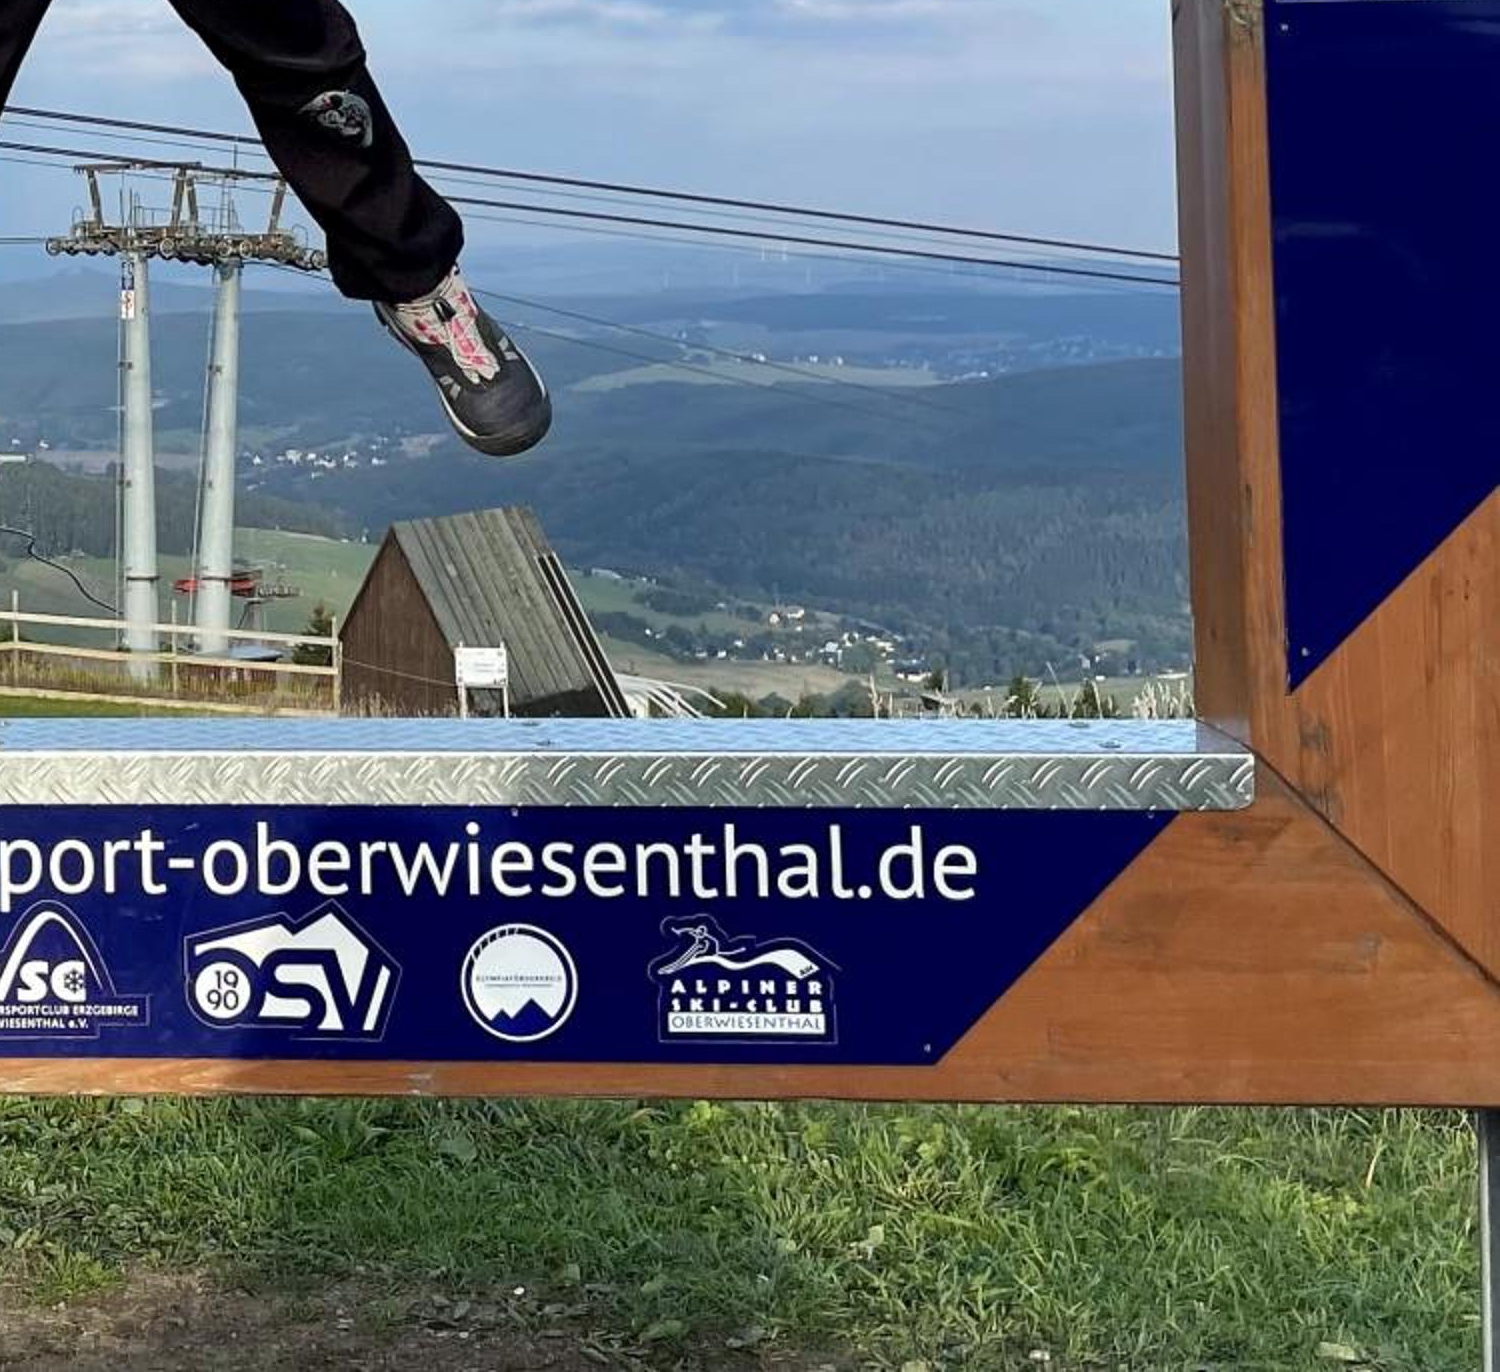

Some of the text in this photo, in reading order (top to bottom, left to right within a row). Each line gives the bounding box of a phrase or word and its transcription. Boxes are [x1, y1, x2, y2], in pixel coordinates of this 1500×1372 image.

[670, 979, 824, 995] ALPINER
[73, 1004, 140, 1017] ERZGEBIRGE
[671, 998, 824, 1013] SKI-CLUB
[67, 1018, 90, 1030] e.V.
[671, 1015, 822, 1031] OBERWIESENTHAL
